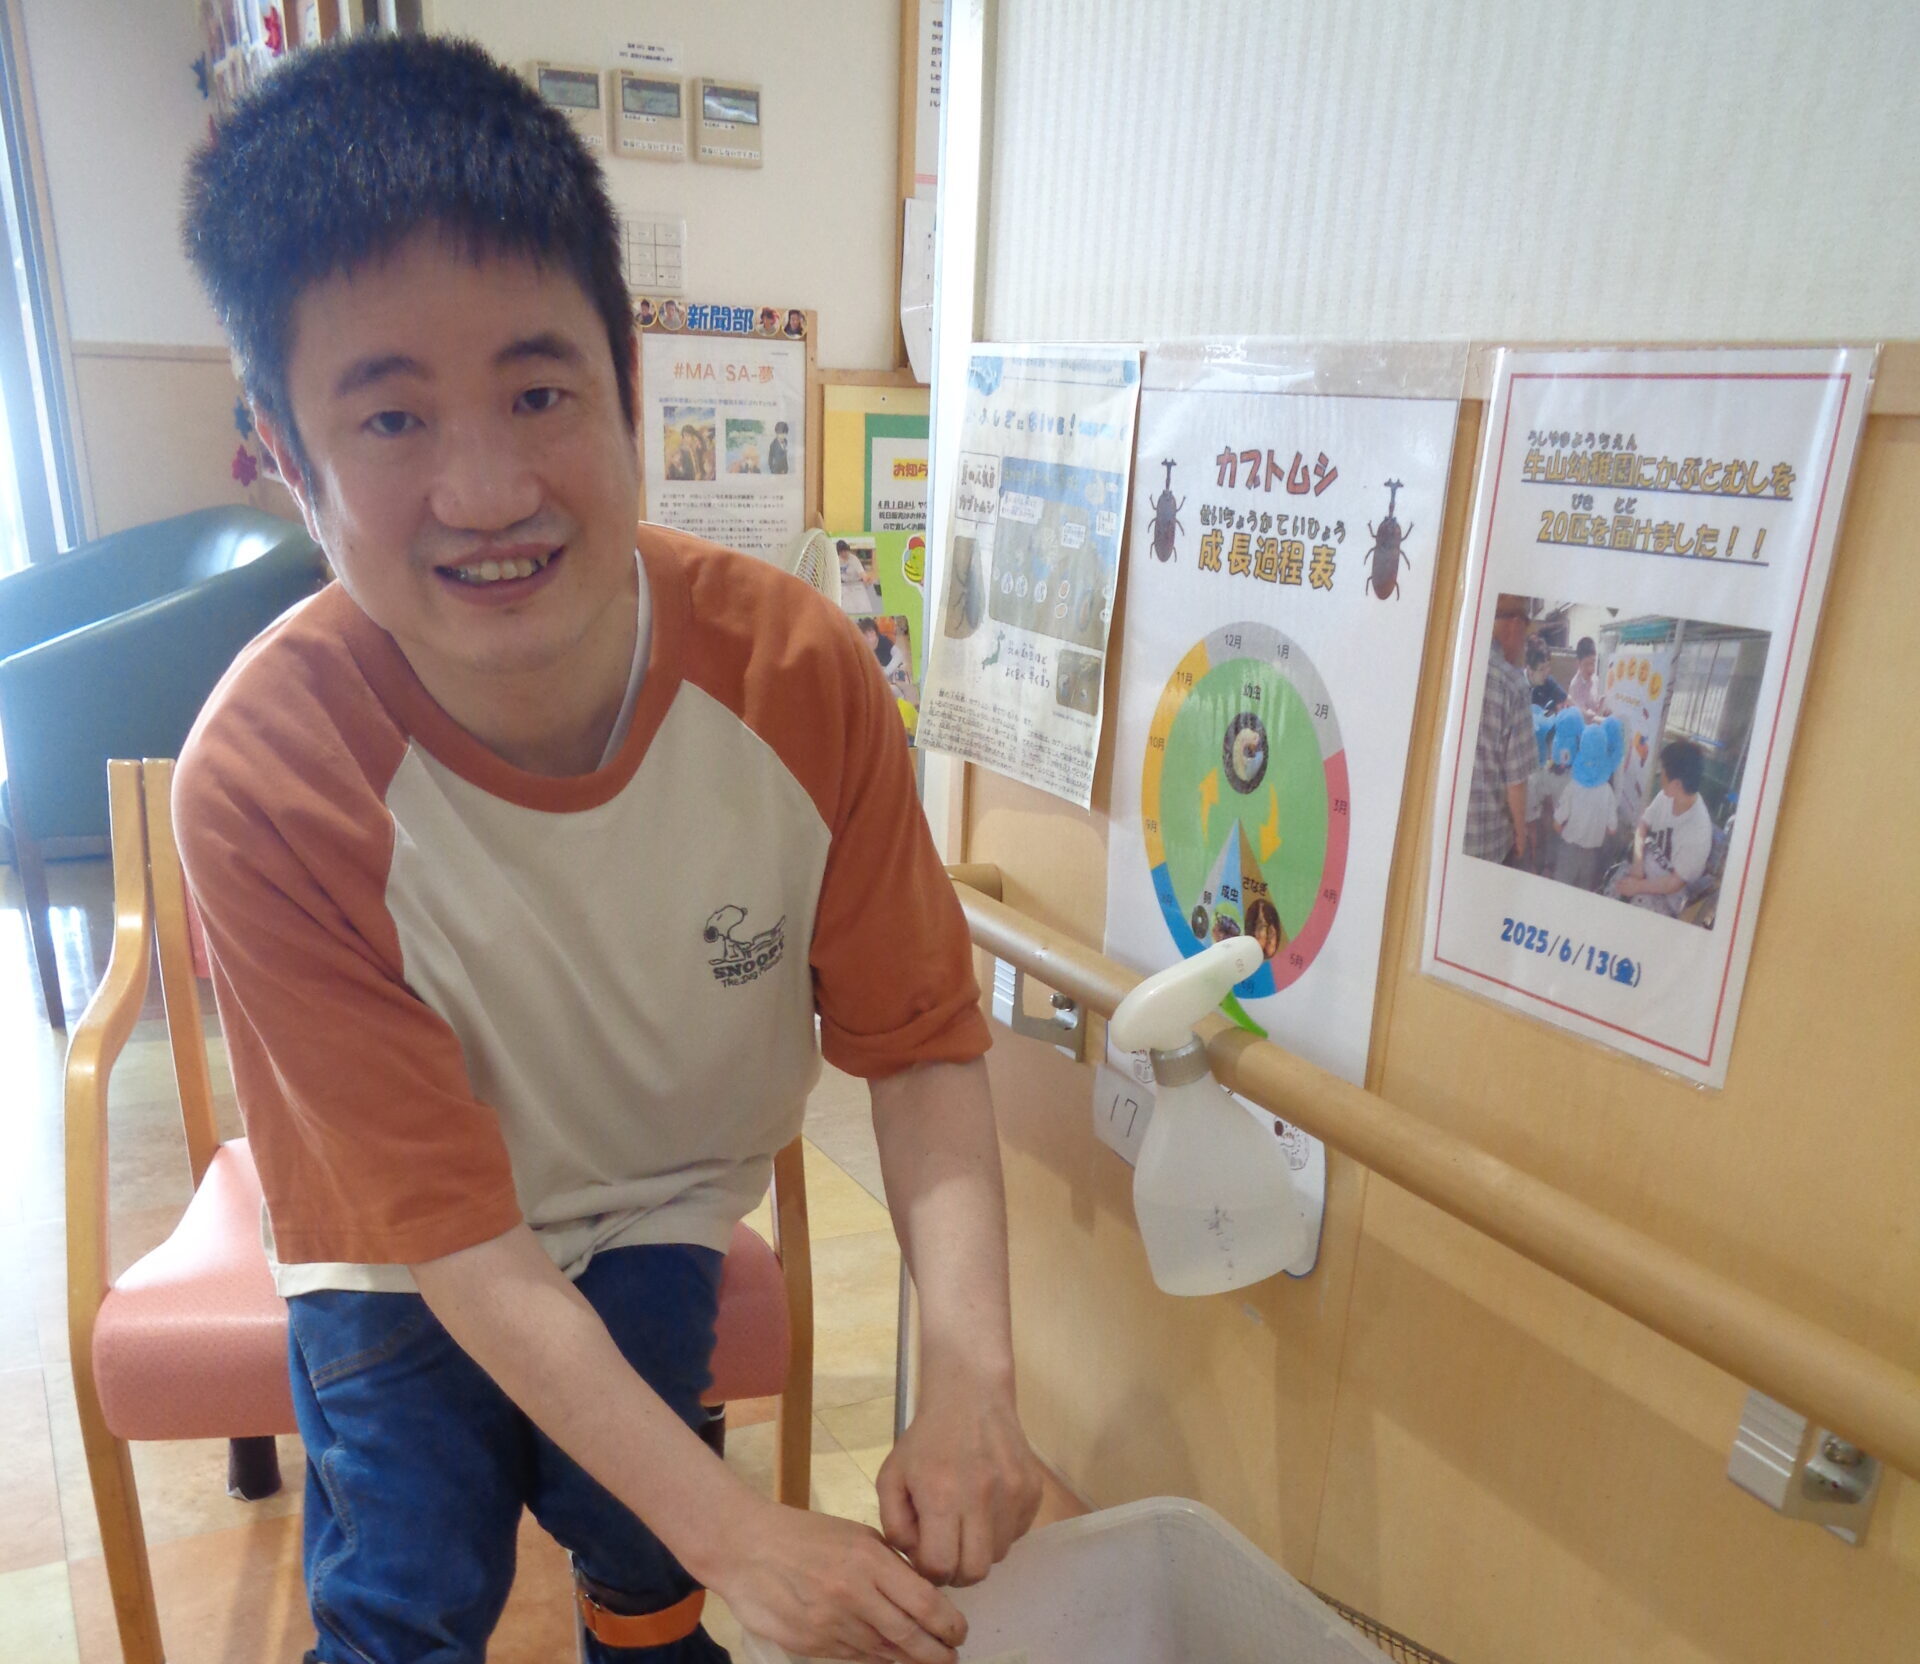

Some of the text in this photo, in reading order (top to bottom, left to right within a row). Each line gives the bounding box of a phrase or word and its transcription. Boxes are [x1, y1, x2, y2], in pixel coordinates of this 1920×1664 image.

[687, 304, 754, 333] 新聞部
[1522, 448, 1796, 498] 牛山幼稚園にかぶとむしを
[1199, 504, 1346, 544] せいちょうかていひょう
[1198, 528, 1337, 592] 成長過程表
[1224, 634, 1242, 649] 12月
[1276, 644, 1290, 659] 1月
[1176, 671, 1193, 686] 11月
[1314, 703, 1329, 720] 2月
[1221, 884, 1239, 904] 成虫
[1242, 876, 1268, 897] さなぎ
[1500, 917, 1641, 989] 2025/6/13(金)
[1110, 1093, 1138, 1137] 17
